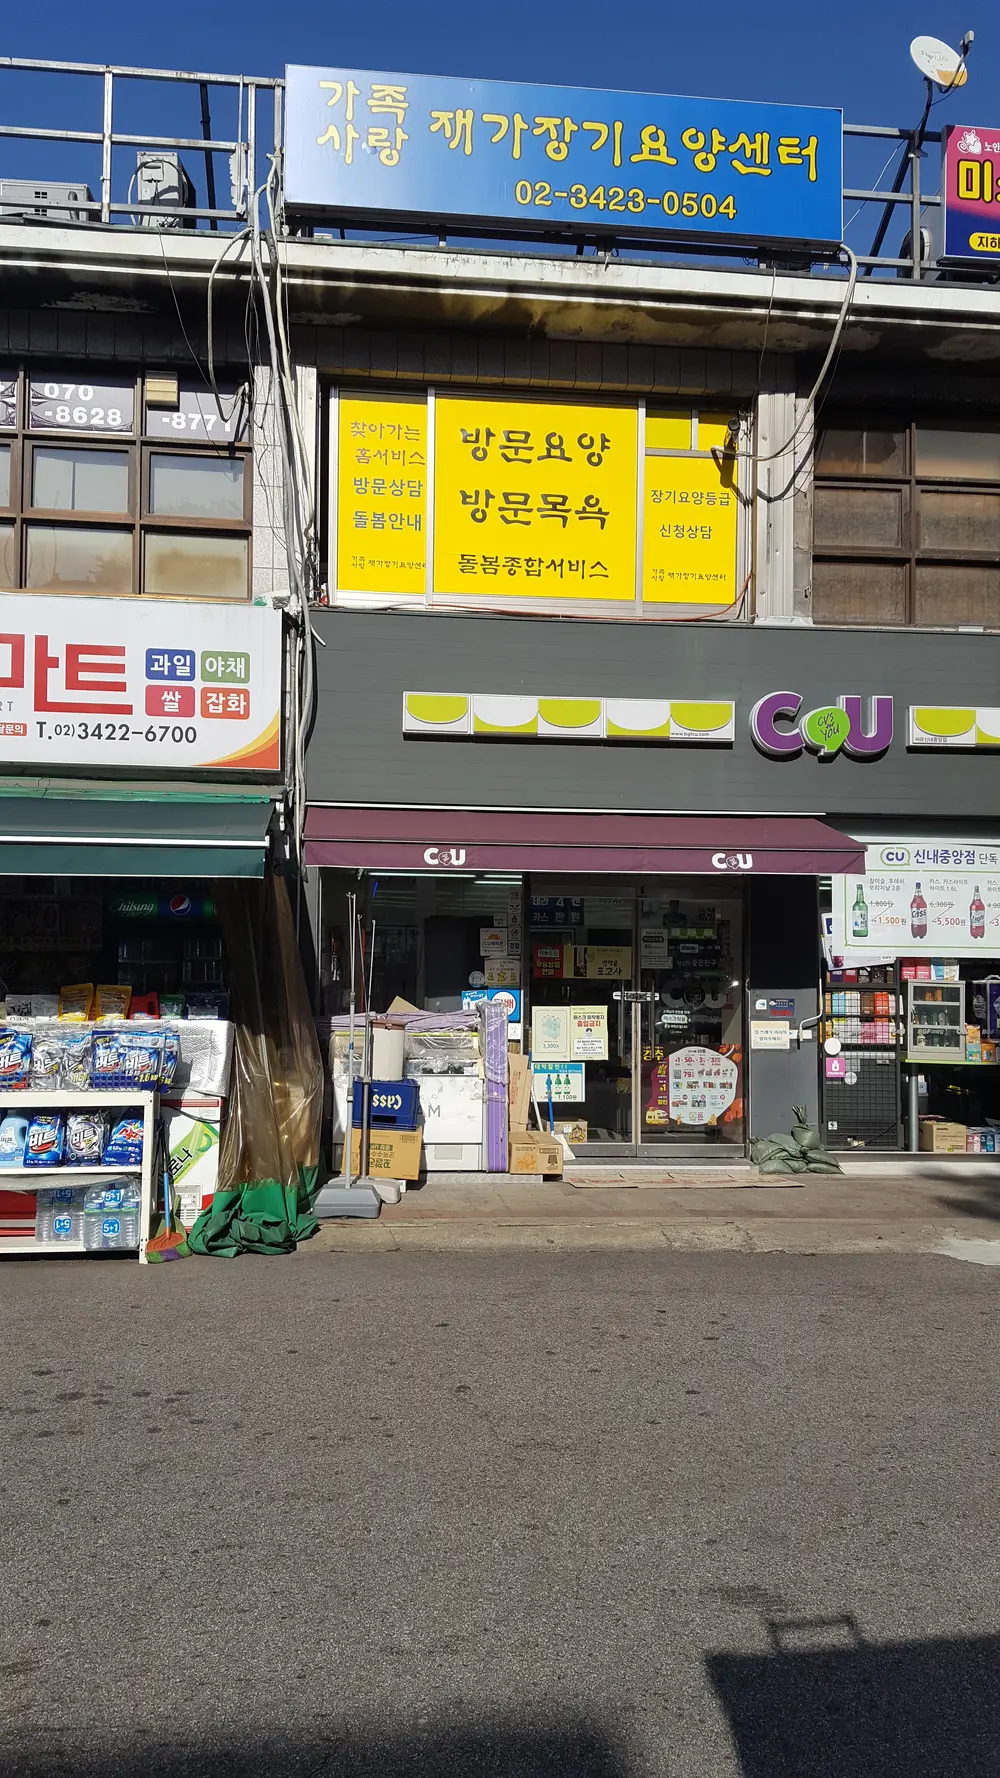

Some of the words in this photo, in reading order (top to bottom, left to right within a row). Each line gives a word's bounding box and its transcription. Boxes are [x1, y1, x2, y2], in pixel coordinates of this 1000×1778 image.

[318, 79, 410, 126] 가족
[316, 123, 410, 167] 사랑
[429, 108, 819, 183] 재가장기요양센터
[514, 179, 737, 221] 02-3423-0504
[44, 383, 93, 401] 070
[44, 406, 122, 426] -8628
[350, 420, 421, 442] 찾아가는
[460, 426, 612, 467] 방문요양
[355, 448, 426, 467] 홈서비스
[353, 476, 424, 498] 방문상담
[650, 489, 732, 507] 장기요양등급
[459, 488, 611, 531] 방문목욕
[352, 510, 423, 532] 돌봄안내
[659, 523, 714, 541] 신청상담
[457, 553, 610, 580] 돌봄종합서비스
[0, 633, 133, 716] 마트
[150, 654, 192, 677] 과일
[204, 656, 246, 679] 야채
[161, 690, 181, 713] 쌀
[205, 692, 247, 715] 잡화
[749, 690, 894, 755] CU
[817, 712, 834, 726] CVS
[820, 725, 840, 741] YOU
[423, 847, 466, 866] CU
[711, 852, 753, 869] CU
[885, 851, 905, 862] CU
[913, 849, 975, 865] 신내중앙점
[978, 852, 998, 865] 단독
[577, 1020, 601, 1028] 출입금지
[372, 1093, 403, 1110] Cass
[29, 1129, 57, 1147] 비트
[72, 1128, 96, 1144] 비트
[105, 1191, 120, 1201] 5+1
[103, 1223, 119, 1233] 5+1
